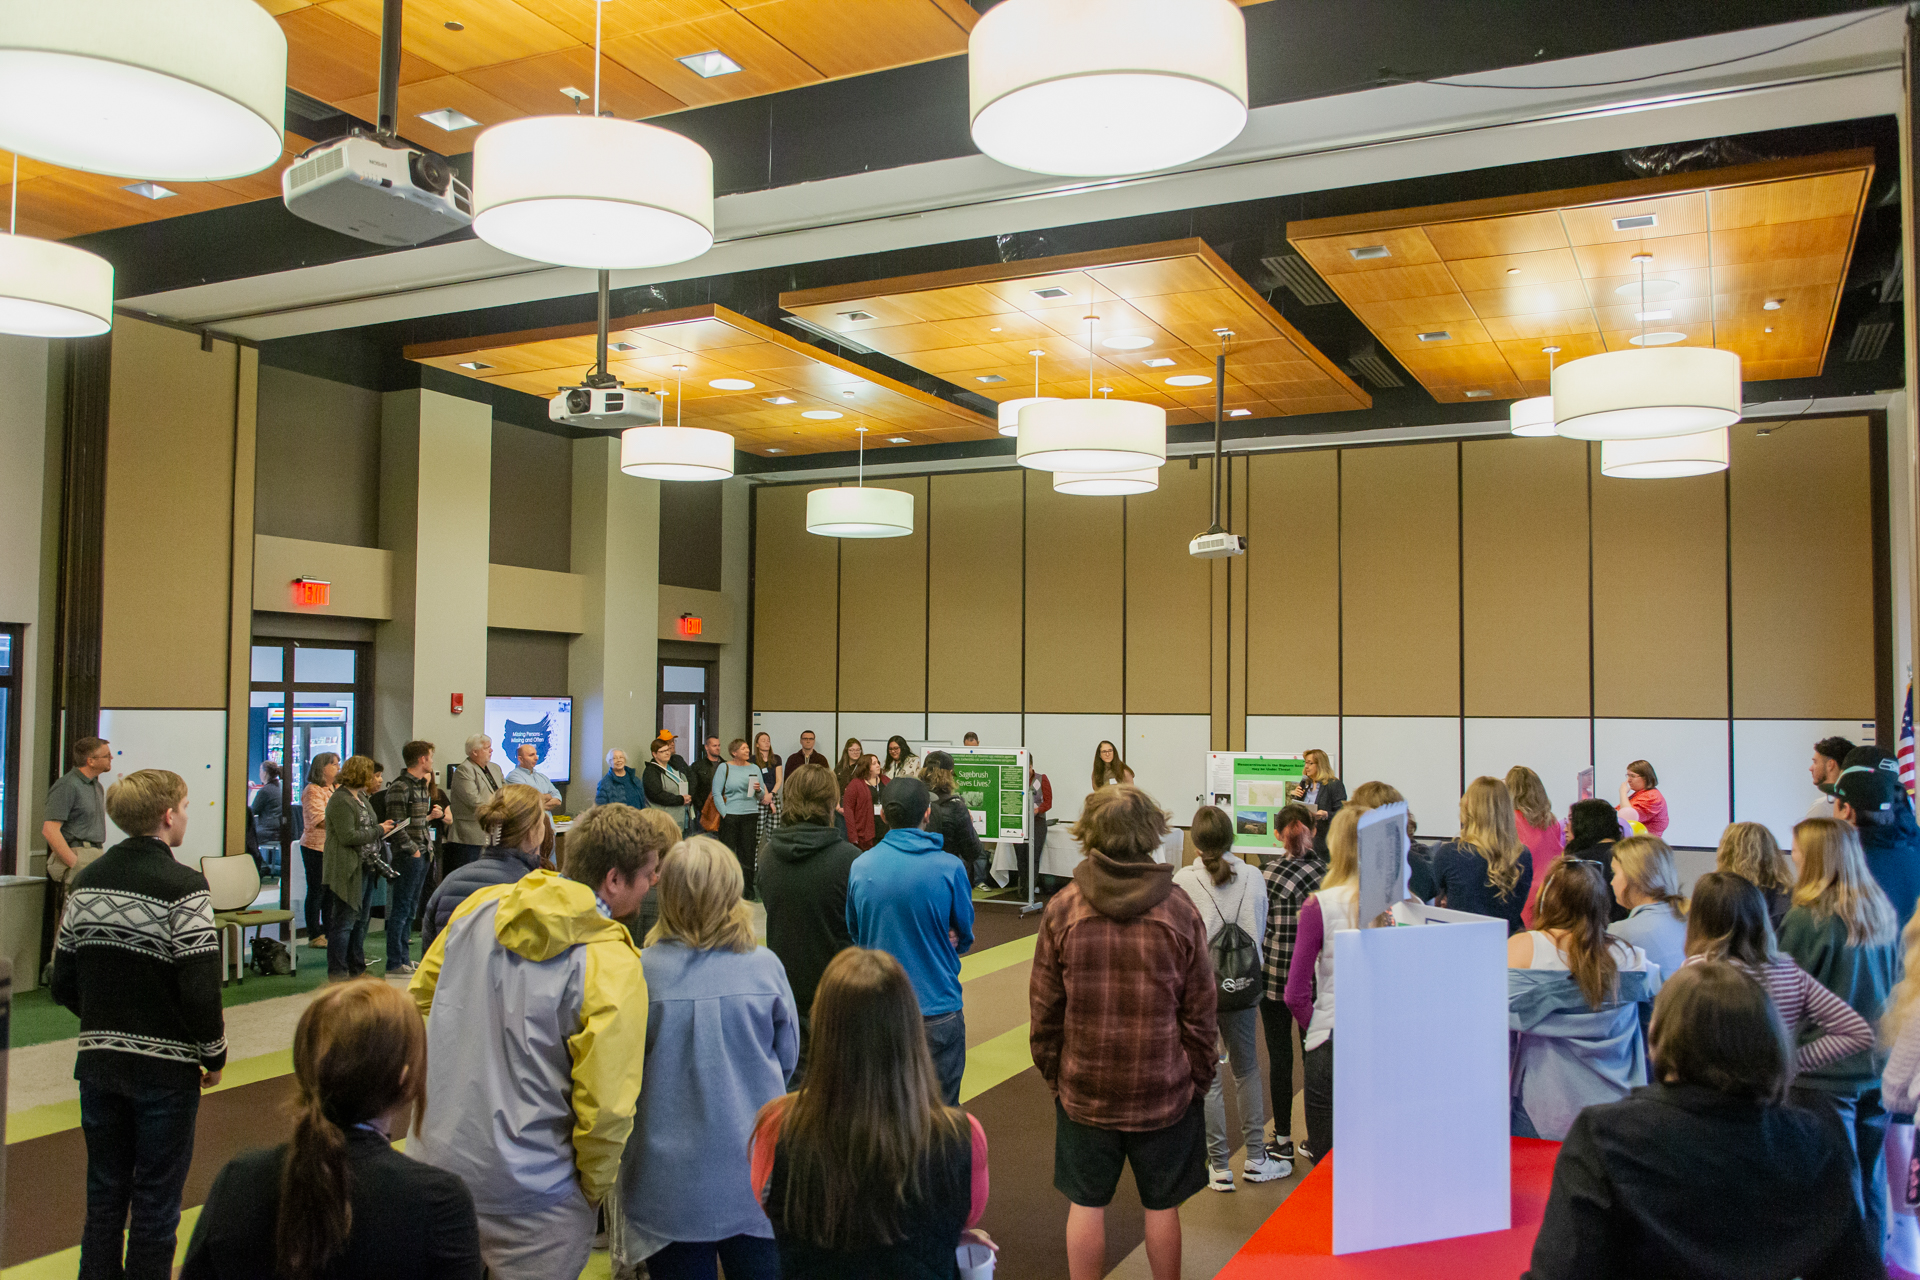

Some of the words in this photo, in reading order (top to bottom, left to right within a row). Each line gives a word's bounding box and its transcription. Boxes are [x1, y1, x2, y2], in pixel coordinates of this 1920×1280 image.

[305, 583, 327, 604] EXIT
[688, 618, 699, 633] EXIT
[958, 770, 988, 780] Sagebrush
